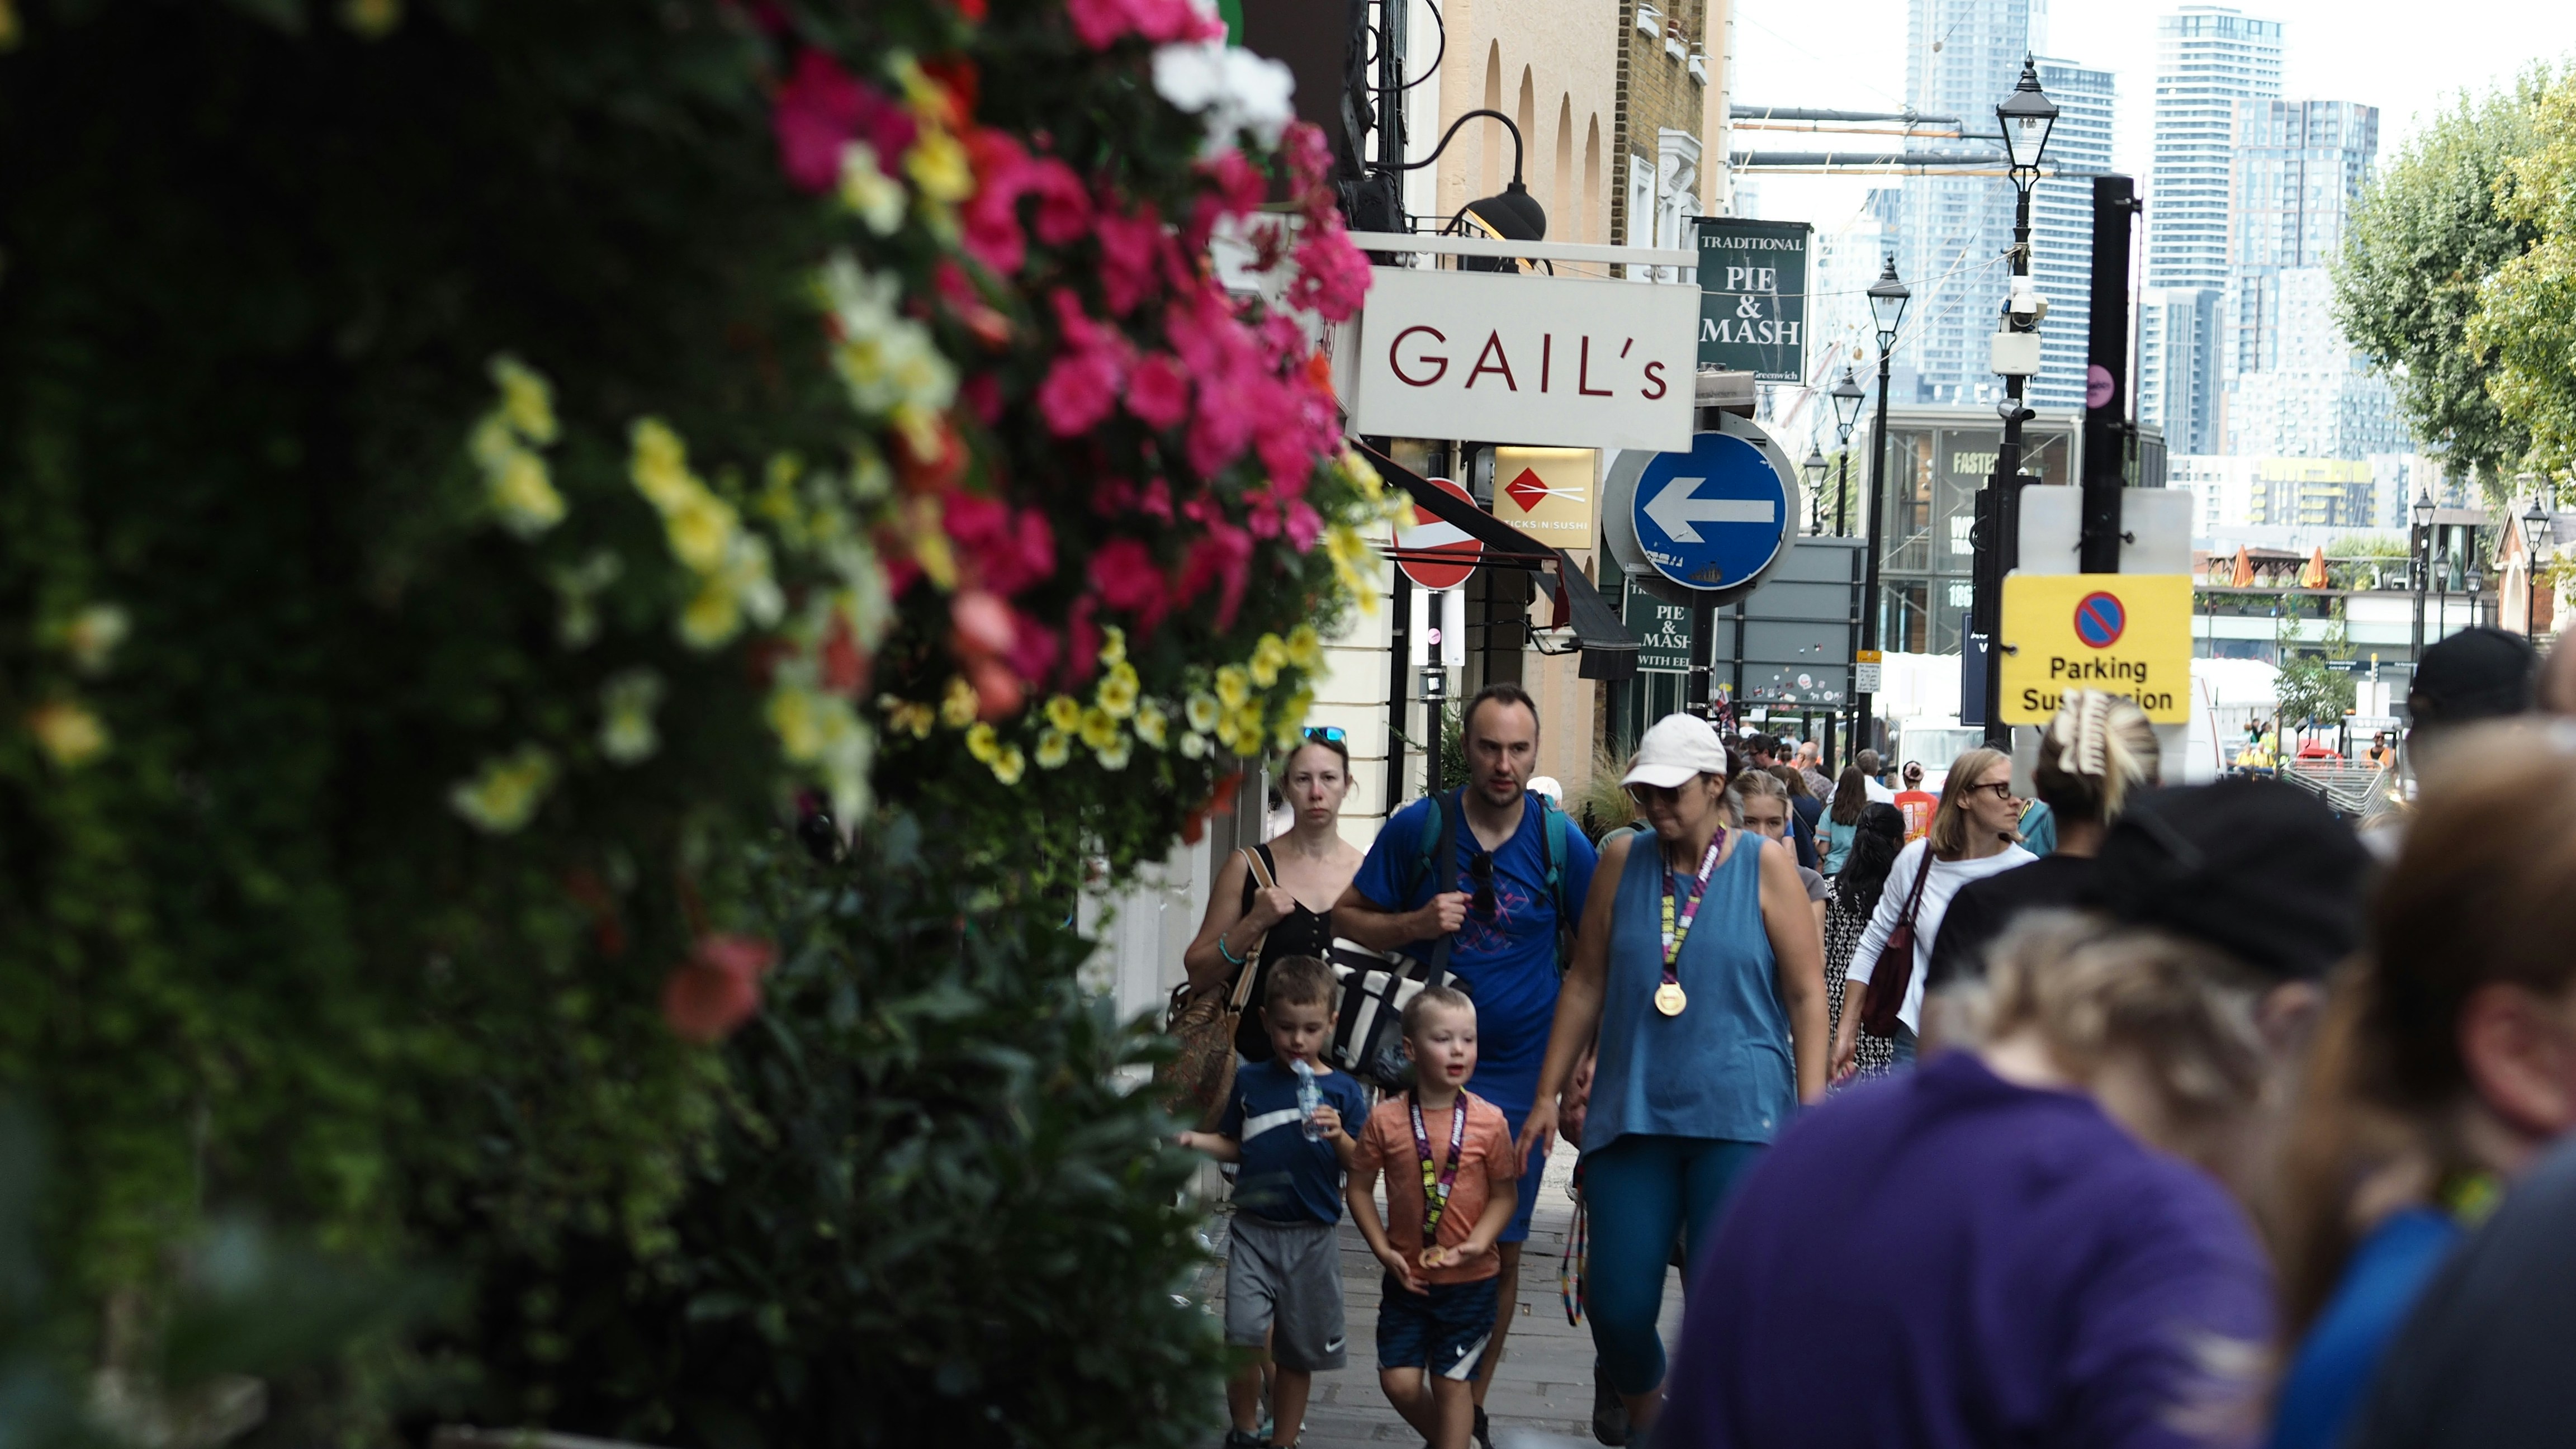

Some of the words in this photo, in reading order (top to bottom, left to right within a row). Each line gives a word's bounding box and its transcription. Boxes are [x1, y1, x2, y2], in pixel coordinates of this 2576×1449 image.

[1701, 236, 1803, 251] TRADITIONAL
[1725, 267, 1776, 291] PIE
[1736, 295, 1763, 319] &
[1699, 318, 1801, 345] MASH
[1390, 325, 1666, 400] GAIL's
[1753, 370, 1797, 380] Greenwich
[1553, 521, 1587, 529] SUSHI
[1656, 605, 1685, 620] PIE
[1662, 621, 1676, 634] &
[1638, 655, 1670, 666] WITH
[2050, 656, 2147, 683] Parking
[1451, 1108, 1464, 1147] FINISHER
